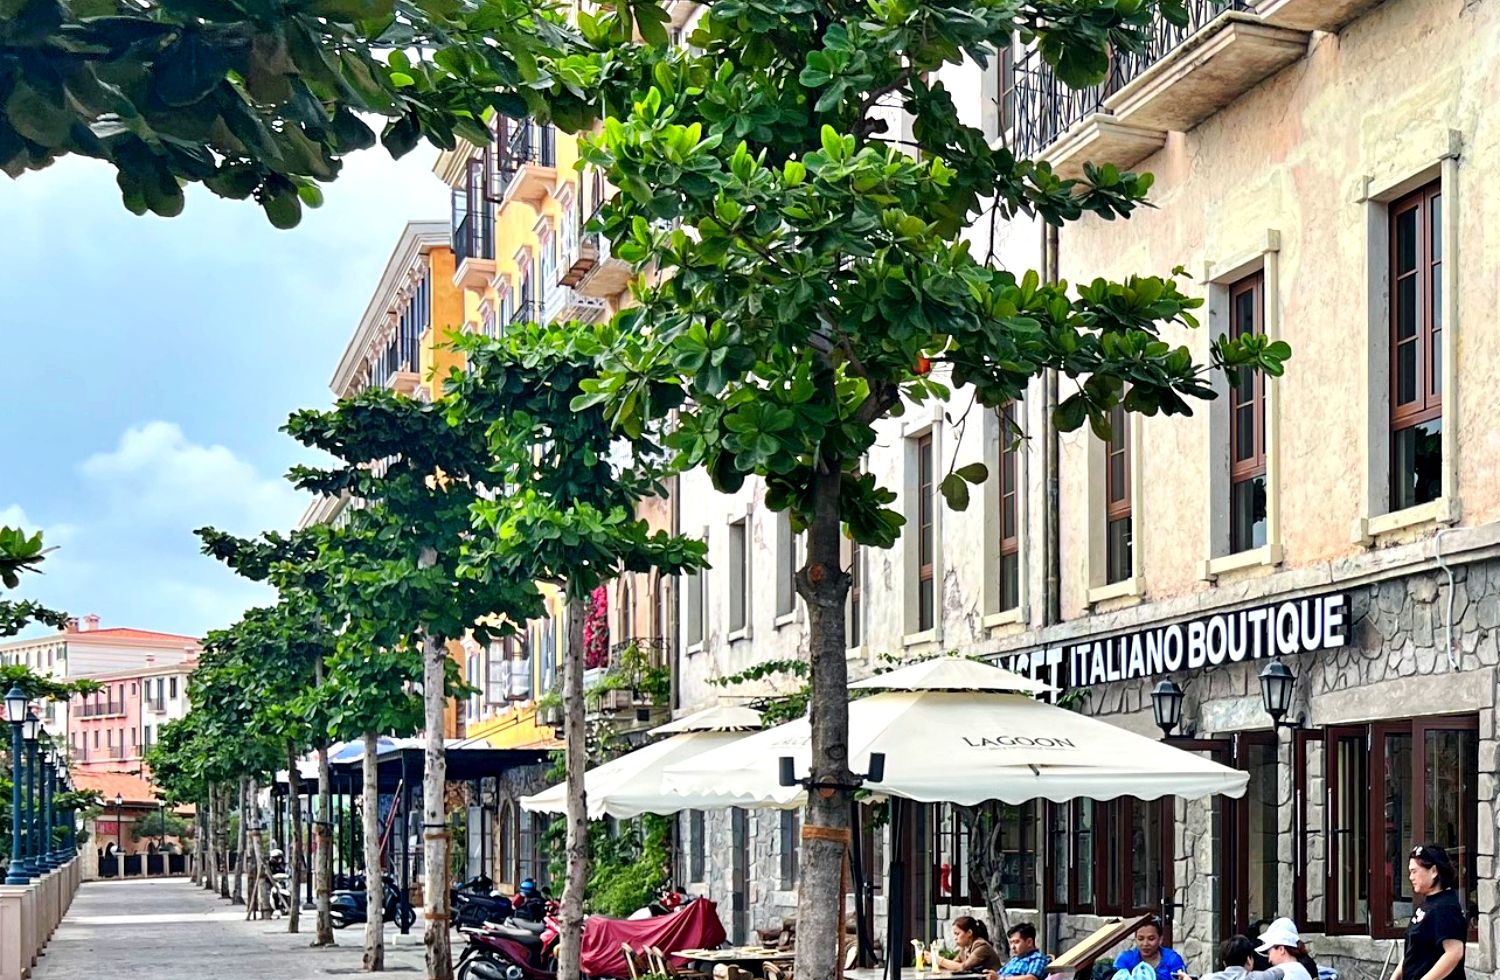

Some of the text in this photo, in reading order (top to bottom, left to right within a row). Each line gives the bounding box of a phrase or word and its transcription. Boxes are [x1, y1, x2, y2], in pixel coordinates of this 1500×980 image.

[1070, 625, 1182, 687] ITALIANO
[1187, 595, 1344, 669] BOUTIQUE
[962, 735, 1076, 748] LAGOON
